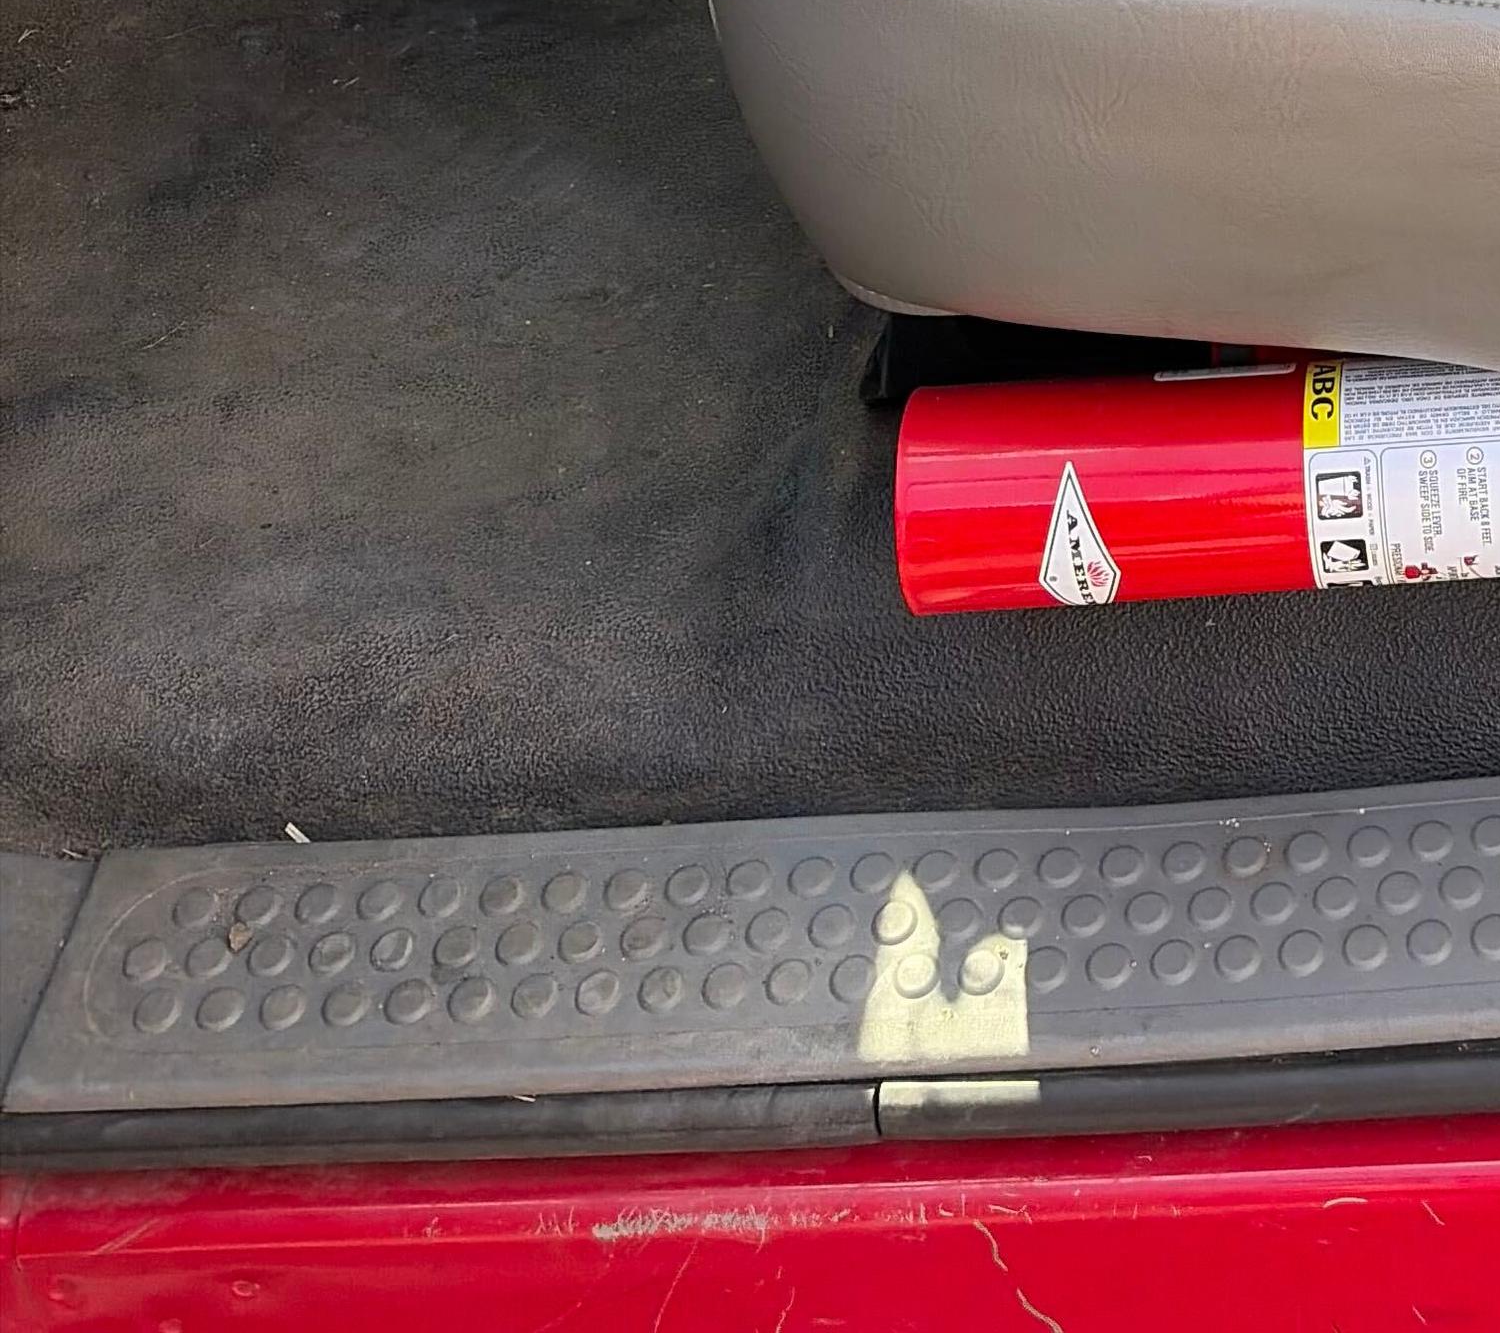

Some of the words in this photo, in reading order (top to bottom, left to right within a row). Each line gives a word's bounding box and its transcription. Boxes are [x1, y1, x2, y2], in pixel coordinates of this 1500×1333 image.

[1311, 364, 1337, 421] ABC
[1418, 470, 1429, 502] SWEEP
[1456, 468, 1466, 482] OF
[1467, 467, 1477, 486] AIM
[1477, 467, 1489, 495] START
[1428, 470, 1440, 509] SQUEEZE
[1469, 487, 1478, 497] AT
[1420, 503, 1431, 523] SIDE
[1469, 497, 1480, 521] BASE
[1480, 496, 1490, 521] BACK
[1422, 523, 1432, 535] TO
[1066, 509, 1097, 604] AMERE
